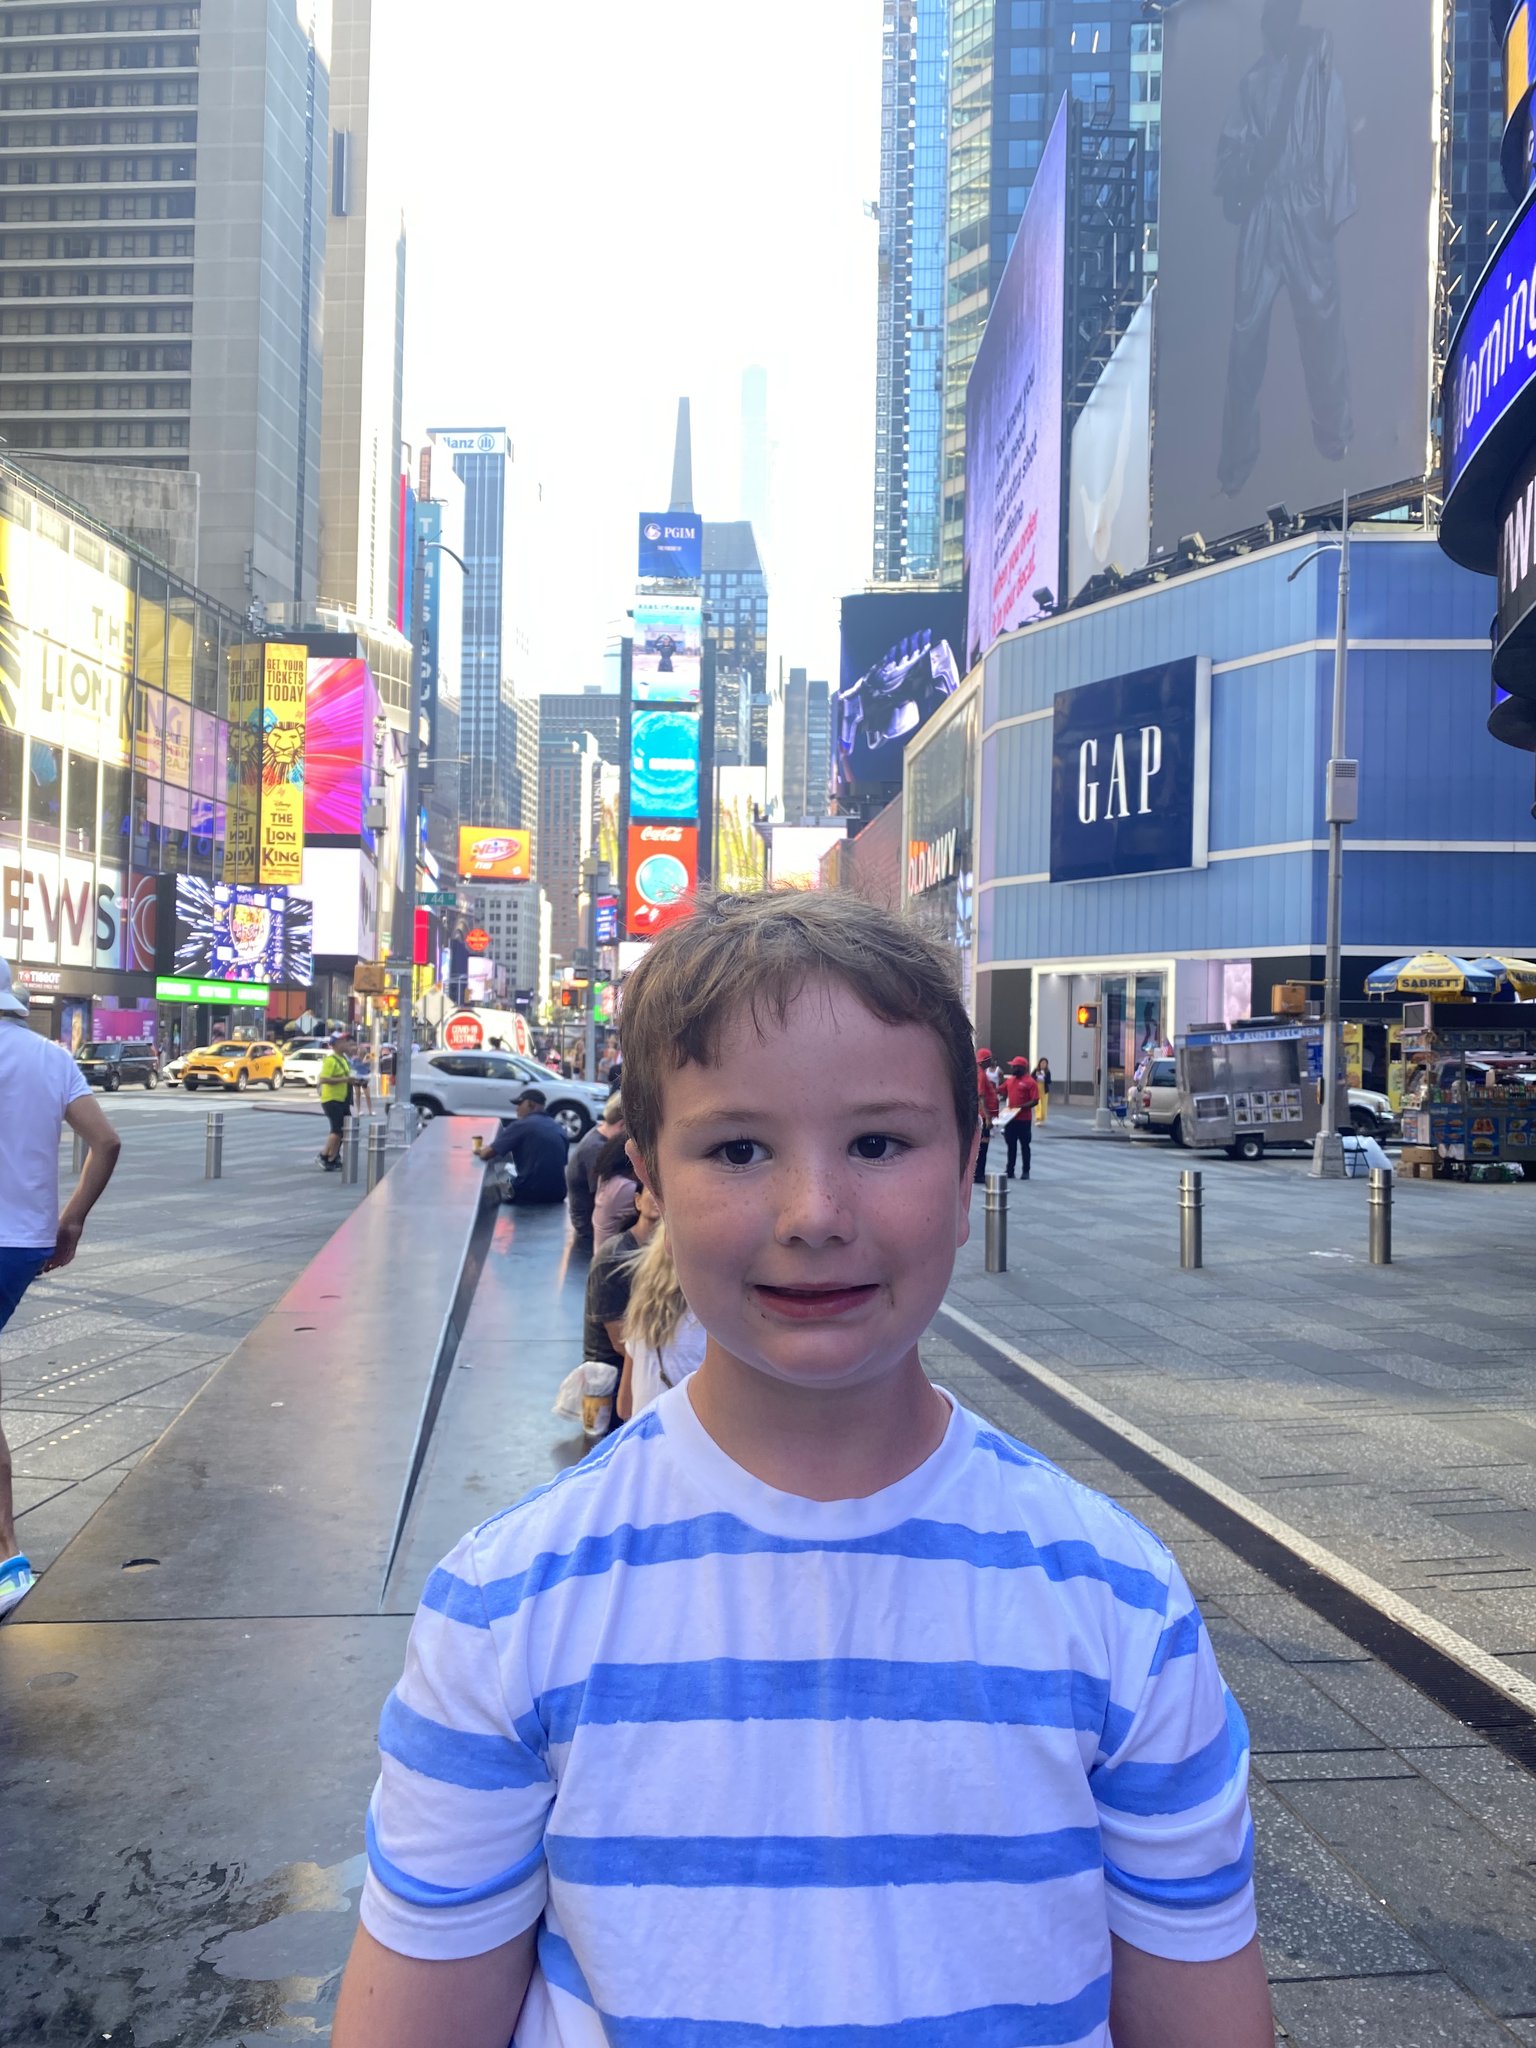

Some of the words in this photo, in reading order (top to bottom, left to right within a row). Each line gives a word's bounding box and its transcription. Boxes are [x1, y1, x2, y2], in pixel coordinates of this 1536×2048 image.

[664, 527, 695, 539] PGIM
[92, 605, 133, 656] THE
[267, 659, 280, 670] GET
[283, 660, 304, 671] YOUR
[41, 627, 112, 717] LION
[267, 670, 304, 685] TICKETS
[267, 685, 304, 702] TODAY
[1078, 725, 1162, 824] GAP
[270, 812, 293, 823] THE
[266, 827, 296, 845] LION
[262, 847, 300, 866] KING
[907, 851, 926, 897] OLD
[926, 827, 957, 888] NAVY
[420, 893, 427, 904] W
[430, 893, 444, 905] 44
[31, 970, 61, 983] TISSOT
[1402, 979, 1460, 988] SABRETT
[451, 1024, 478, 1034] COVID-19
[1244, 1030, 1272, 1040] AUNT
[1275, 1027, 1320, 1040] KITCHEN
[453, 1034, 478, 1044] TESTING
